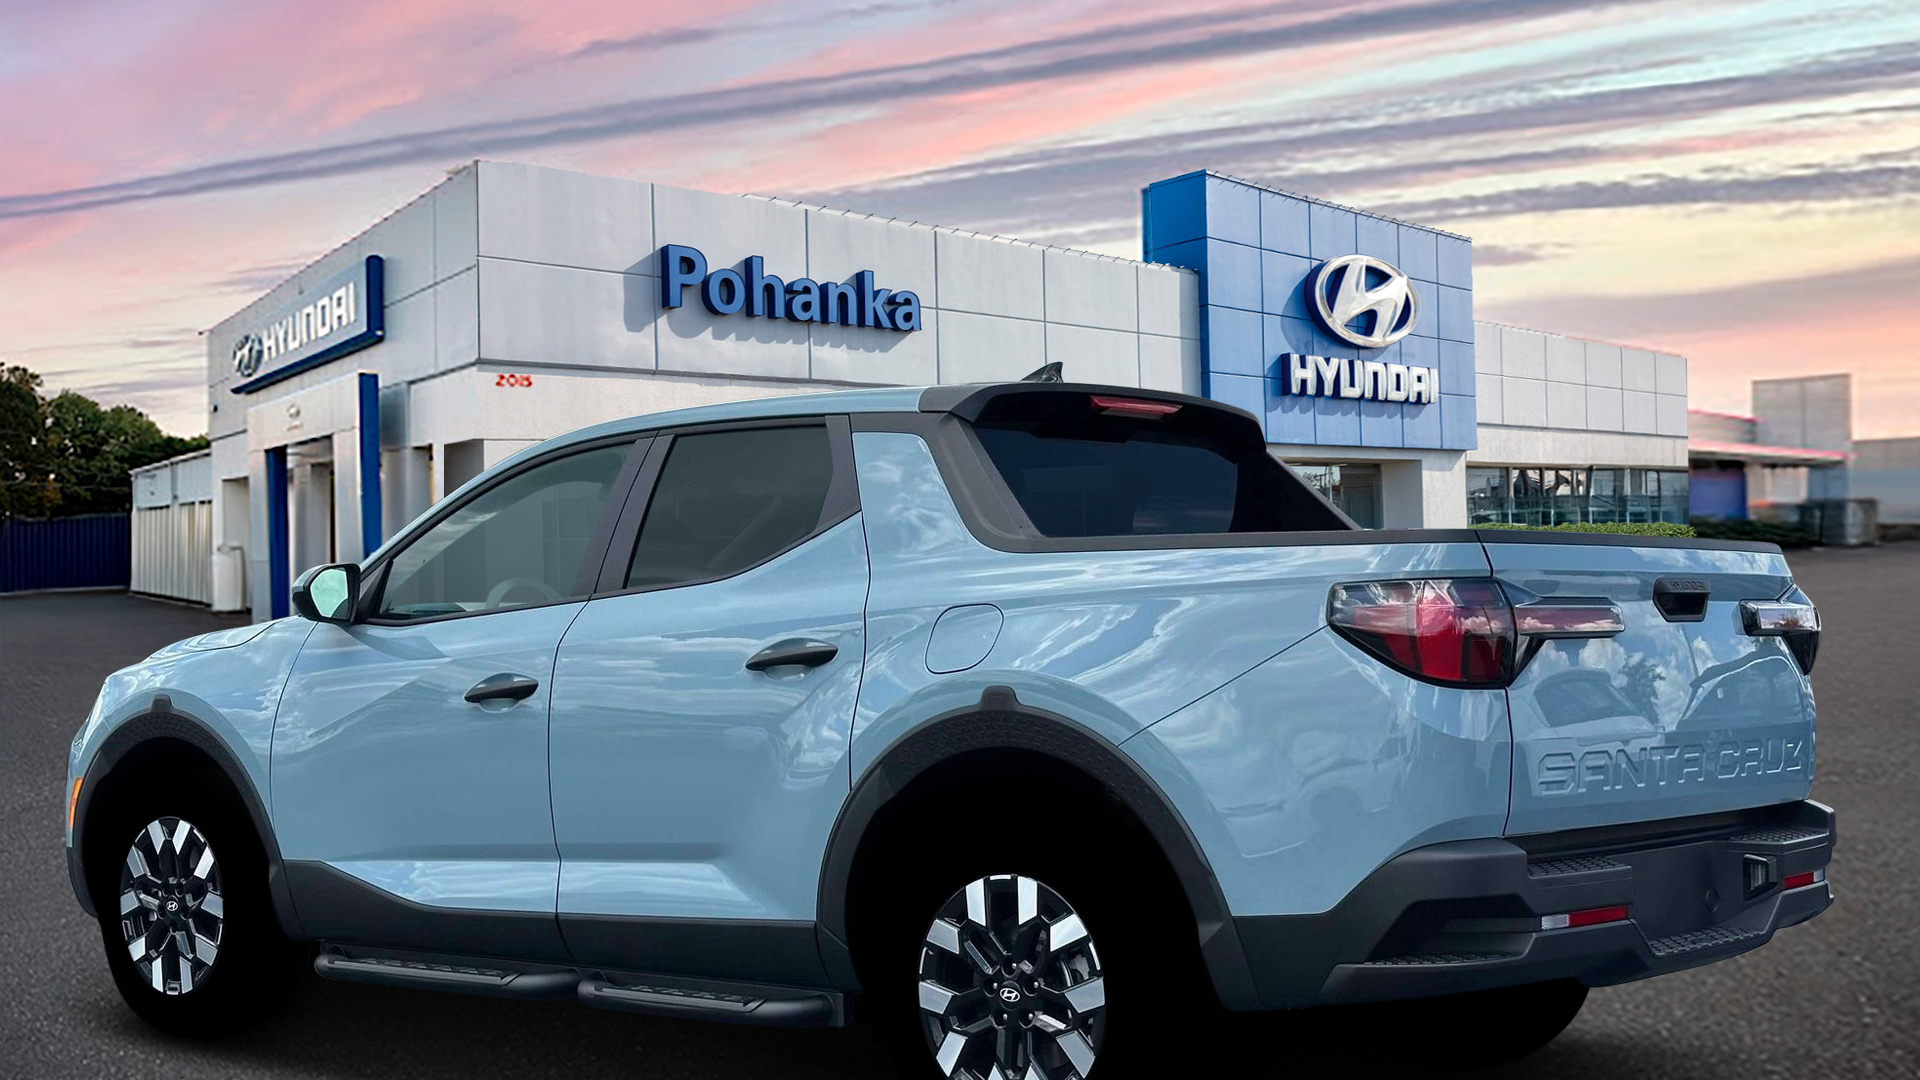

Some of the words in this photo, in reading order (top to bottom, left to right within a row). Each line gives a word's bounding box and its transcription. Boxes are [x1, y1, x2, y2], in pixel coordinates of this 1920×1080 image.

[262, 281, 356, 361] HYUNDAI
[661, 244, 922, 331] Pohanka
[1283, 353, 1439, 404] HYUNDAI
[1538, 745, 1706, 796] SANTA
[1717, 739, 1804, 779] CRUZ
